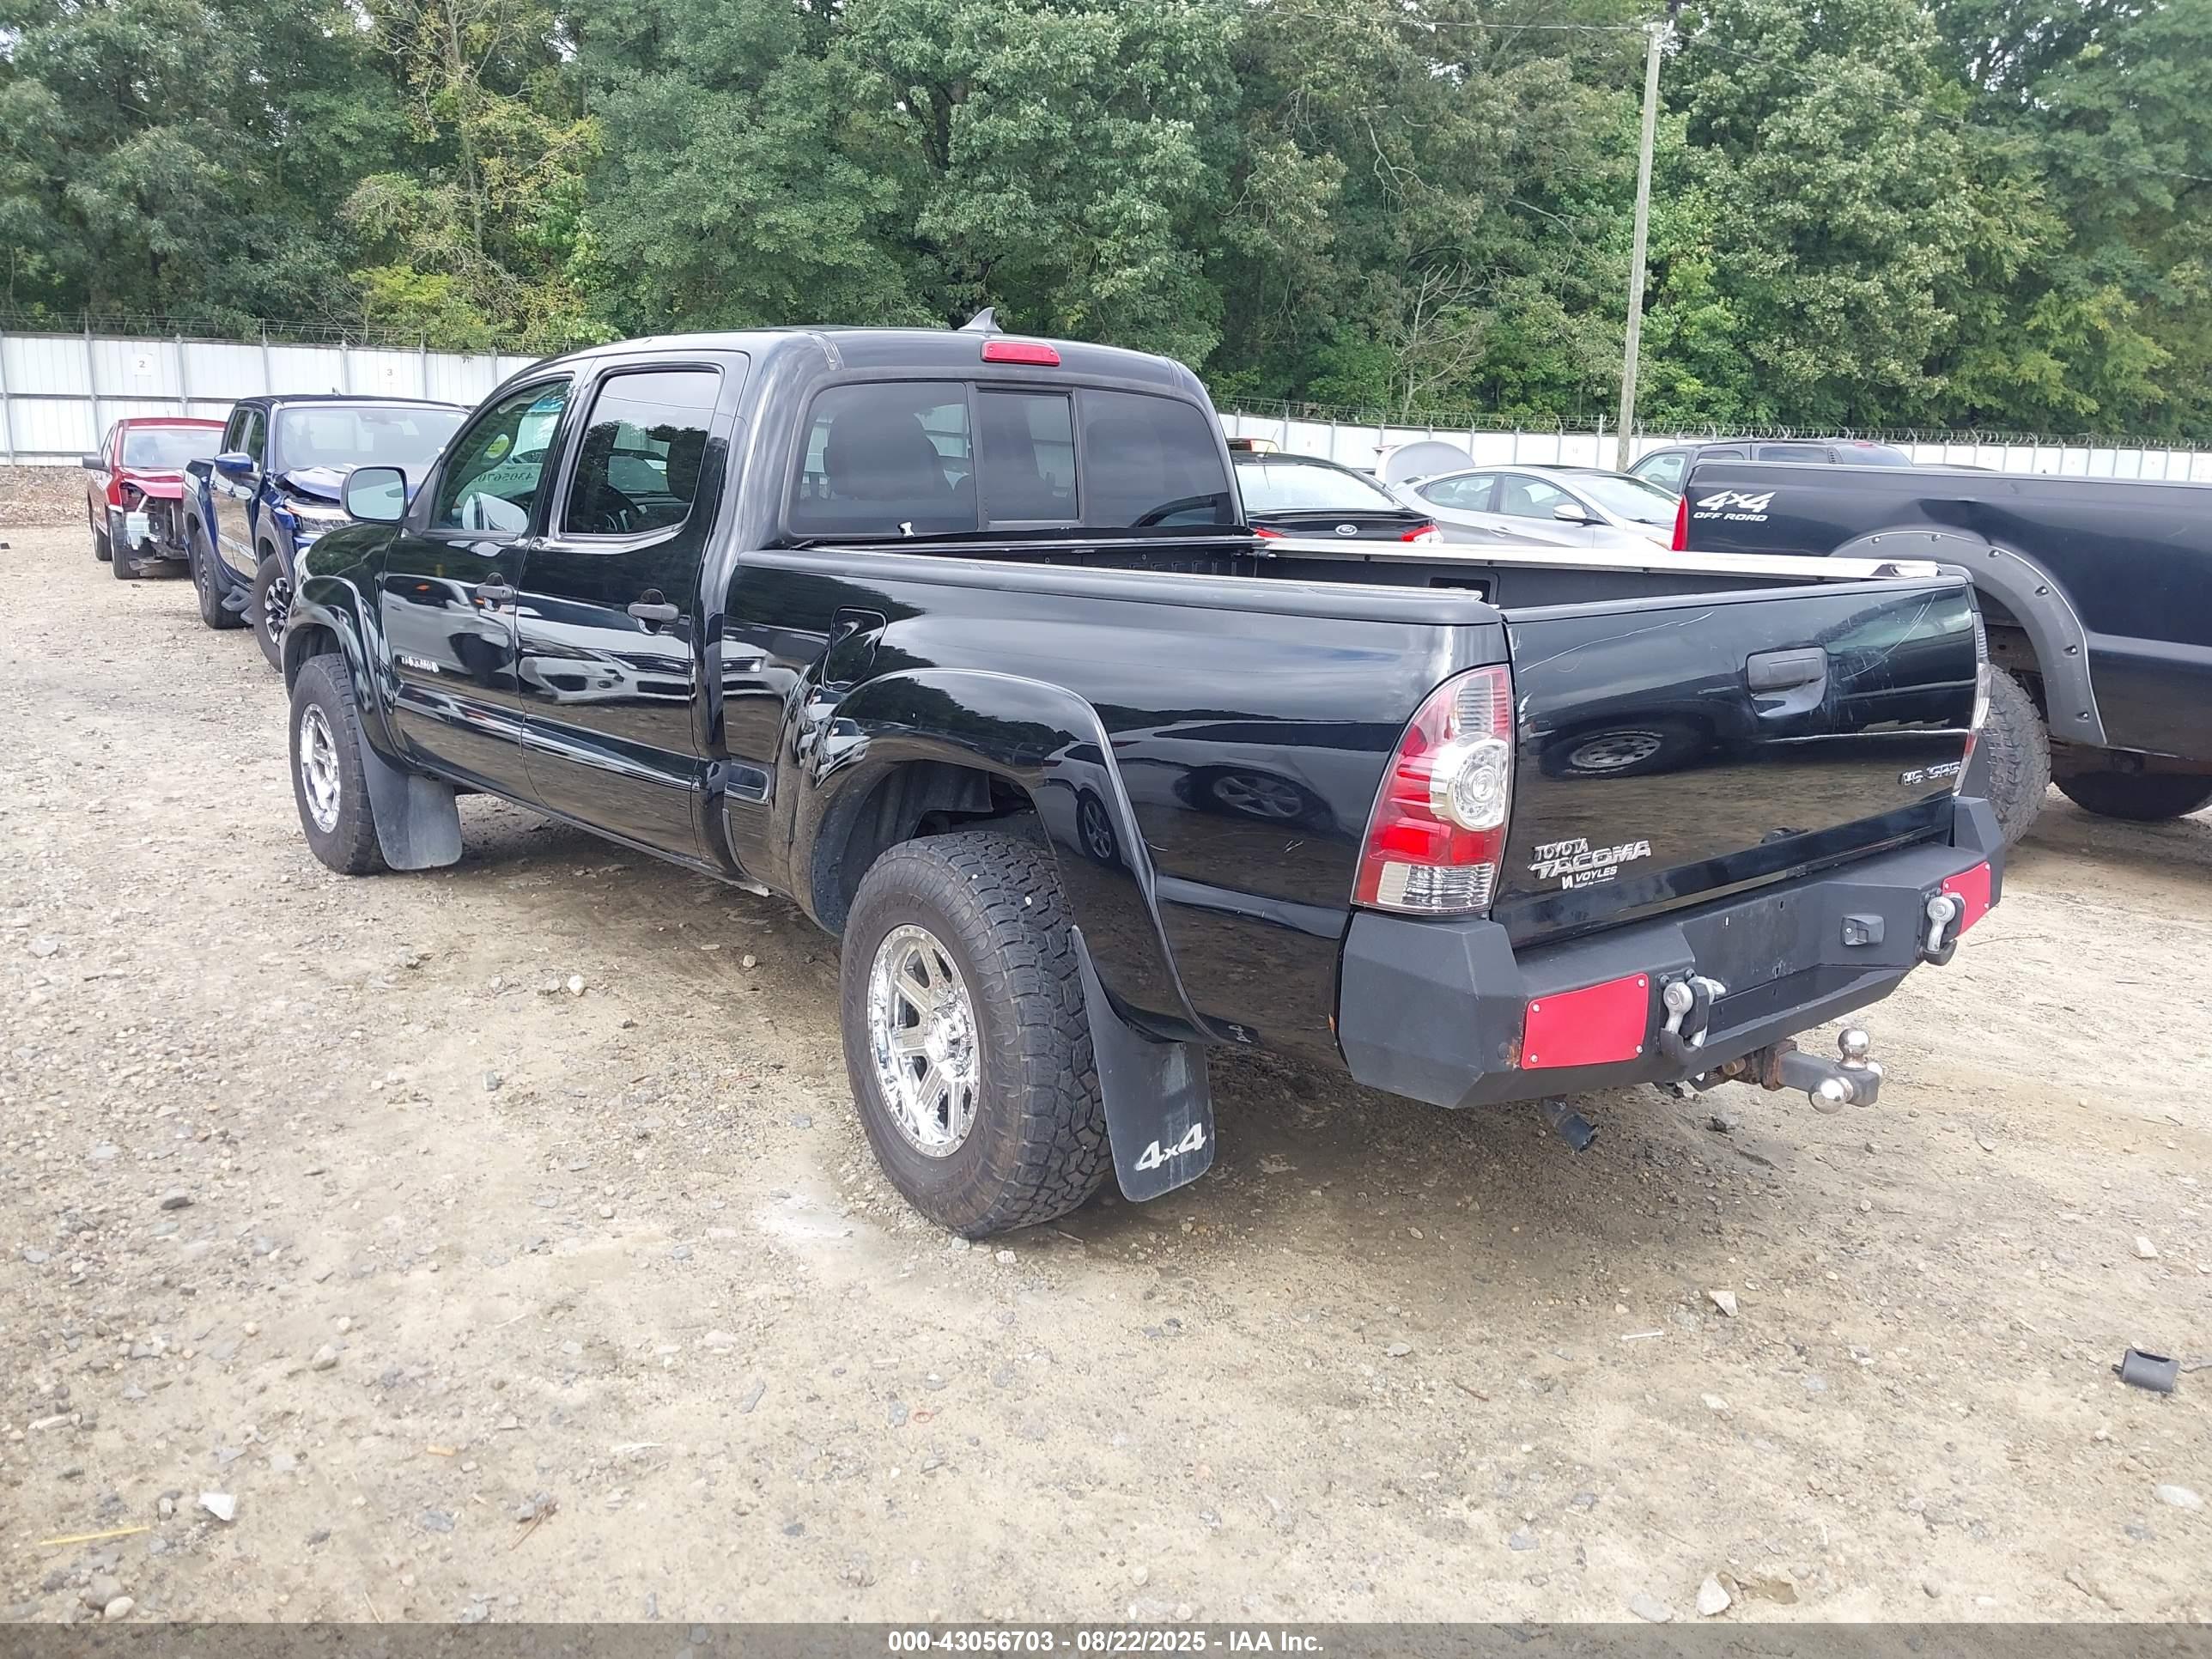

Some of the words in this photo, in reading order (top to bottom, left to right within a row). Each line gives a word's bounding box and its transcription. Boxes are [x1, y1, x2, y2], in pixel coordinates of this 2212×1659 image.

[1696, 489, 1777, 513] 4x4
[1723, 513, 1769, 522] ROAD
[1528, 840, 1652, 880] TACOMA
[1534, 837, 1589, 861] TOYOTA
[1575, 865, 1619, 883] VOYLES
[1134, 1121, 1207, 1172] 4x4
